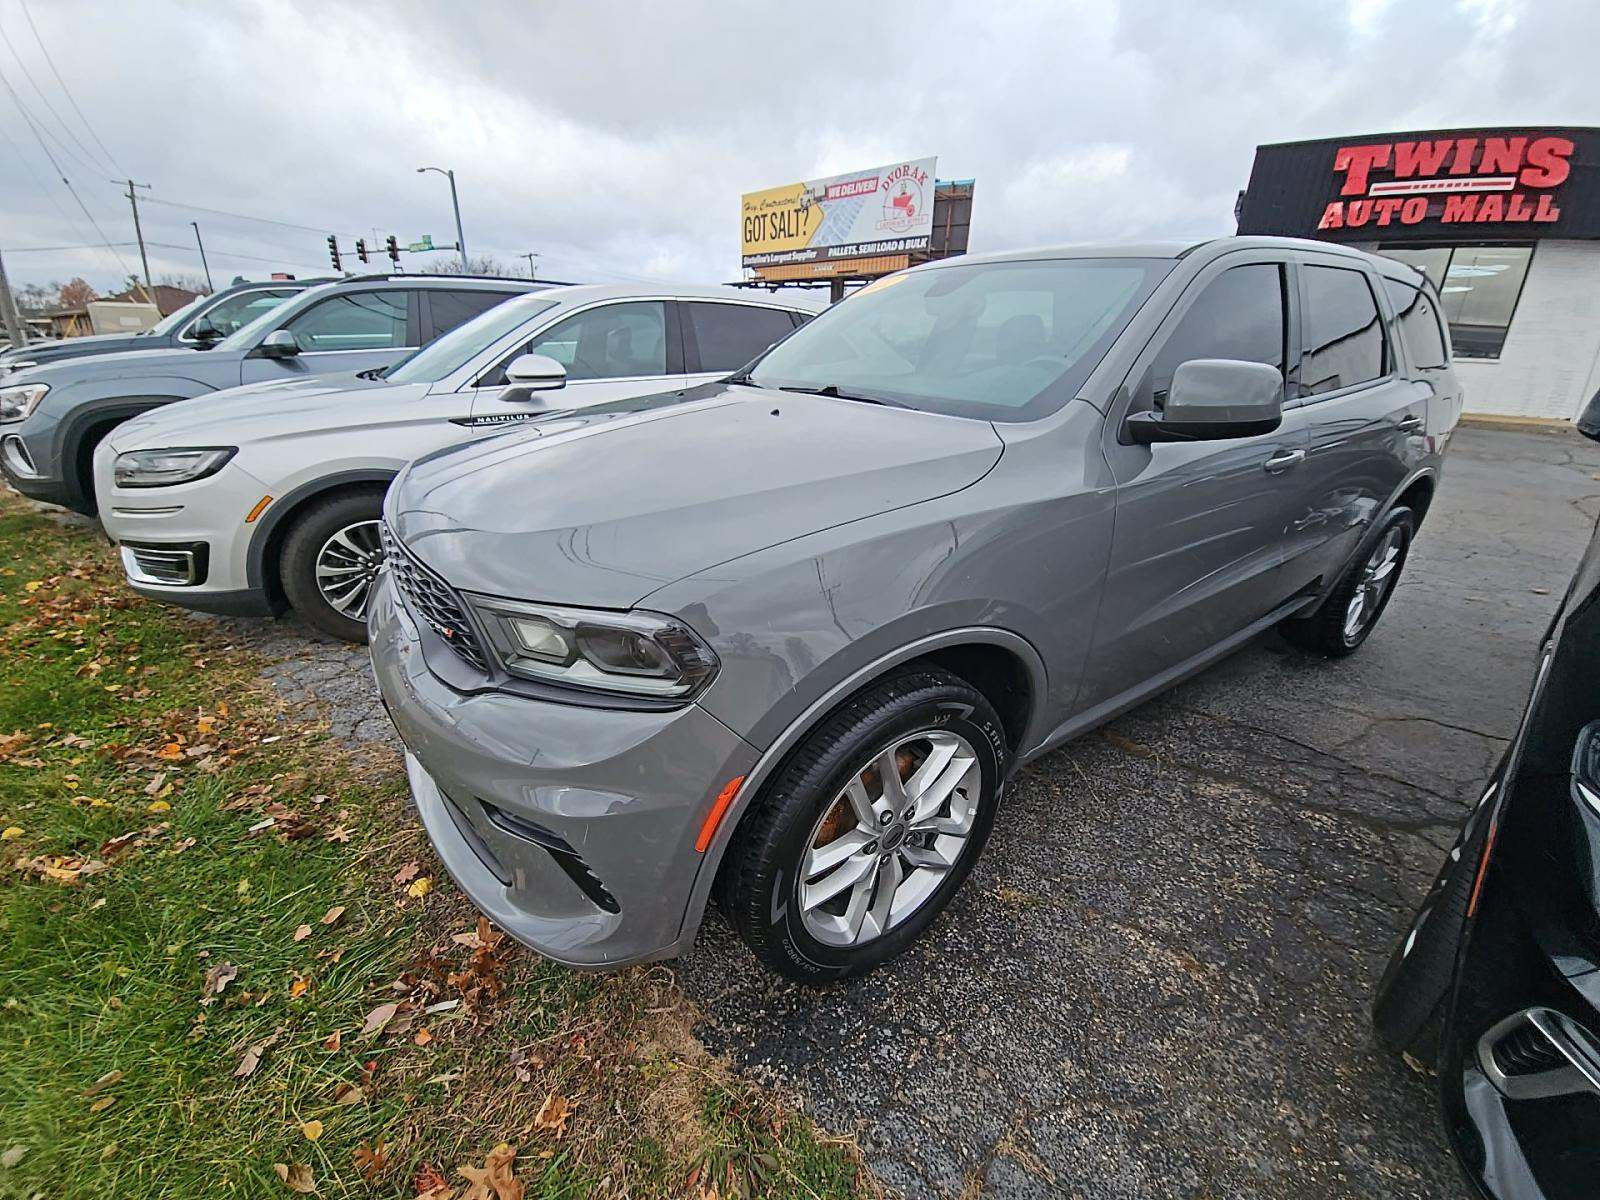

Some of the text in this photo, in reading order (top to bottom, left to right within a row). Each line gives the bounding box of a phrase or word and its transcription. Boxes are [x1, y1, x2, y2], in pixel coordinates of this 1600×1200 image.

[882, 165, 929, 192] DVORAK
[1334, 137, 1574, 195] TWINS
[828, 185, 840, 198] WE
[744, 208, 809, 243] GOT SALT?
[1317, 194, 1562, 230] AUTO MALL
[828, 245, 858, 258] PALLETS,
[859, 243, 877, 254] SEMI
[877, 241, 897, 253] LOAD
[905, 237, 928, 250] BULK
[477, 414, 529, 423] NAUTILUS
